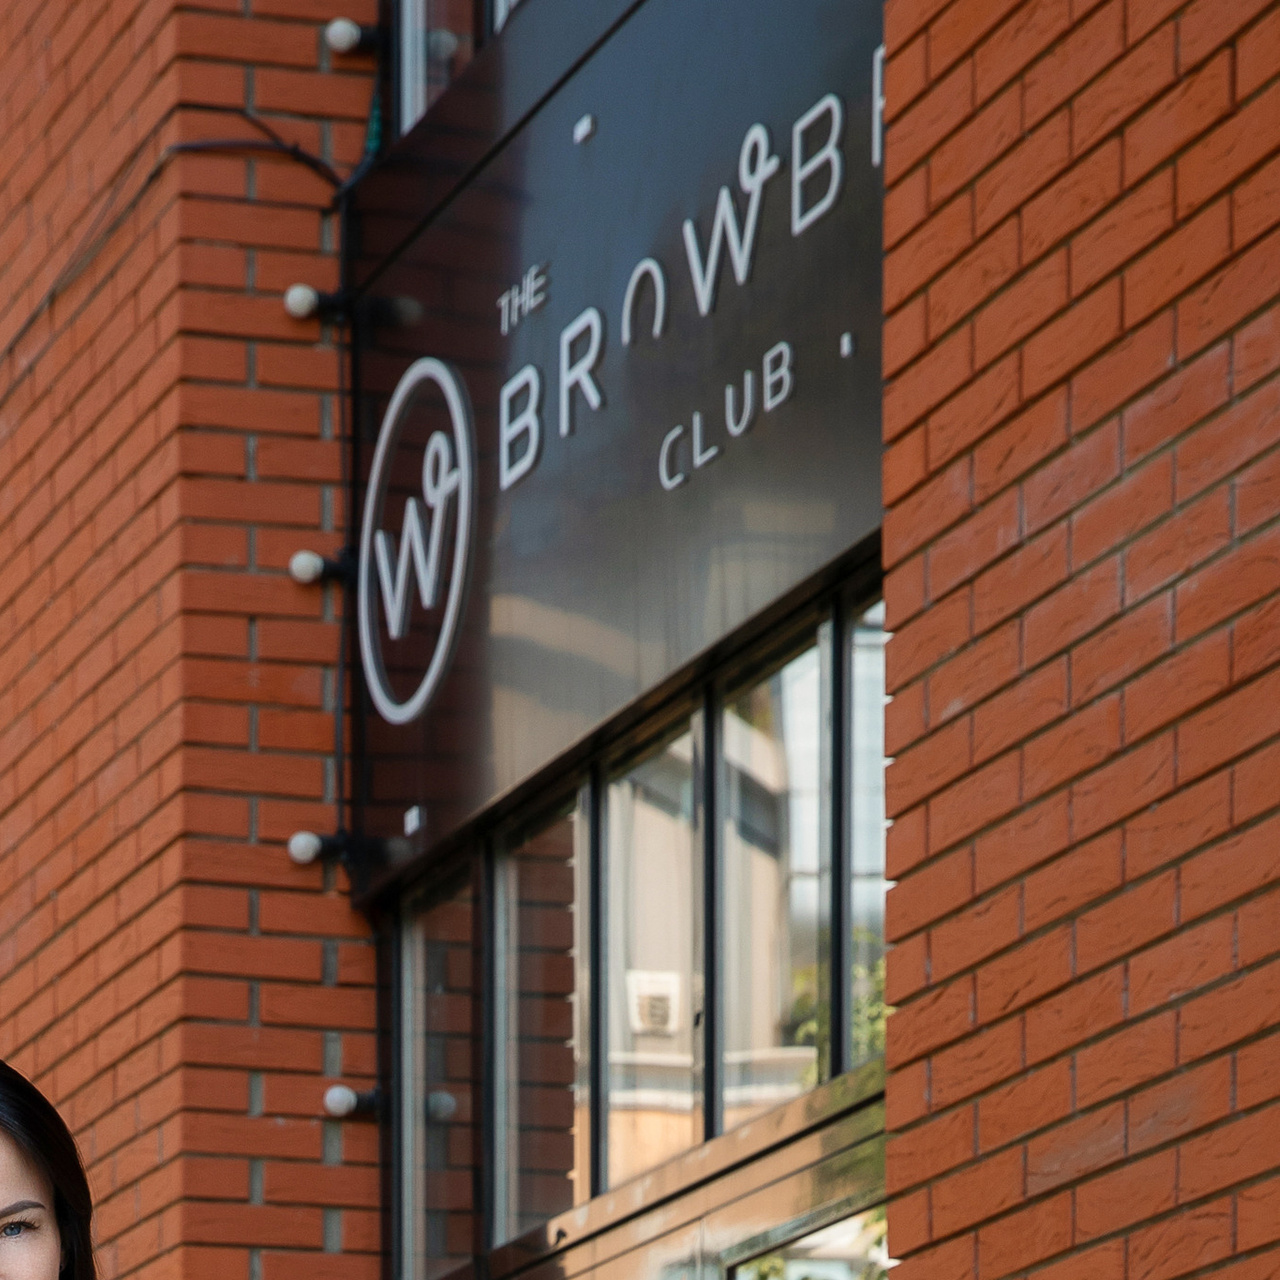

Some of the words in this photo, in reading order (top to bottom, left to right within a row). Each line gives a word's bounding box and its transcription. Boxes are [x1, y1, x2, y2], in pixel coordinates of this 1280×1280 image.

[495, 264, 548, 336] THE
[499, 44, 886, 491] BROWB
[658, 340, 792, 490] CLUB
